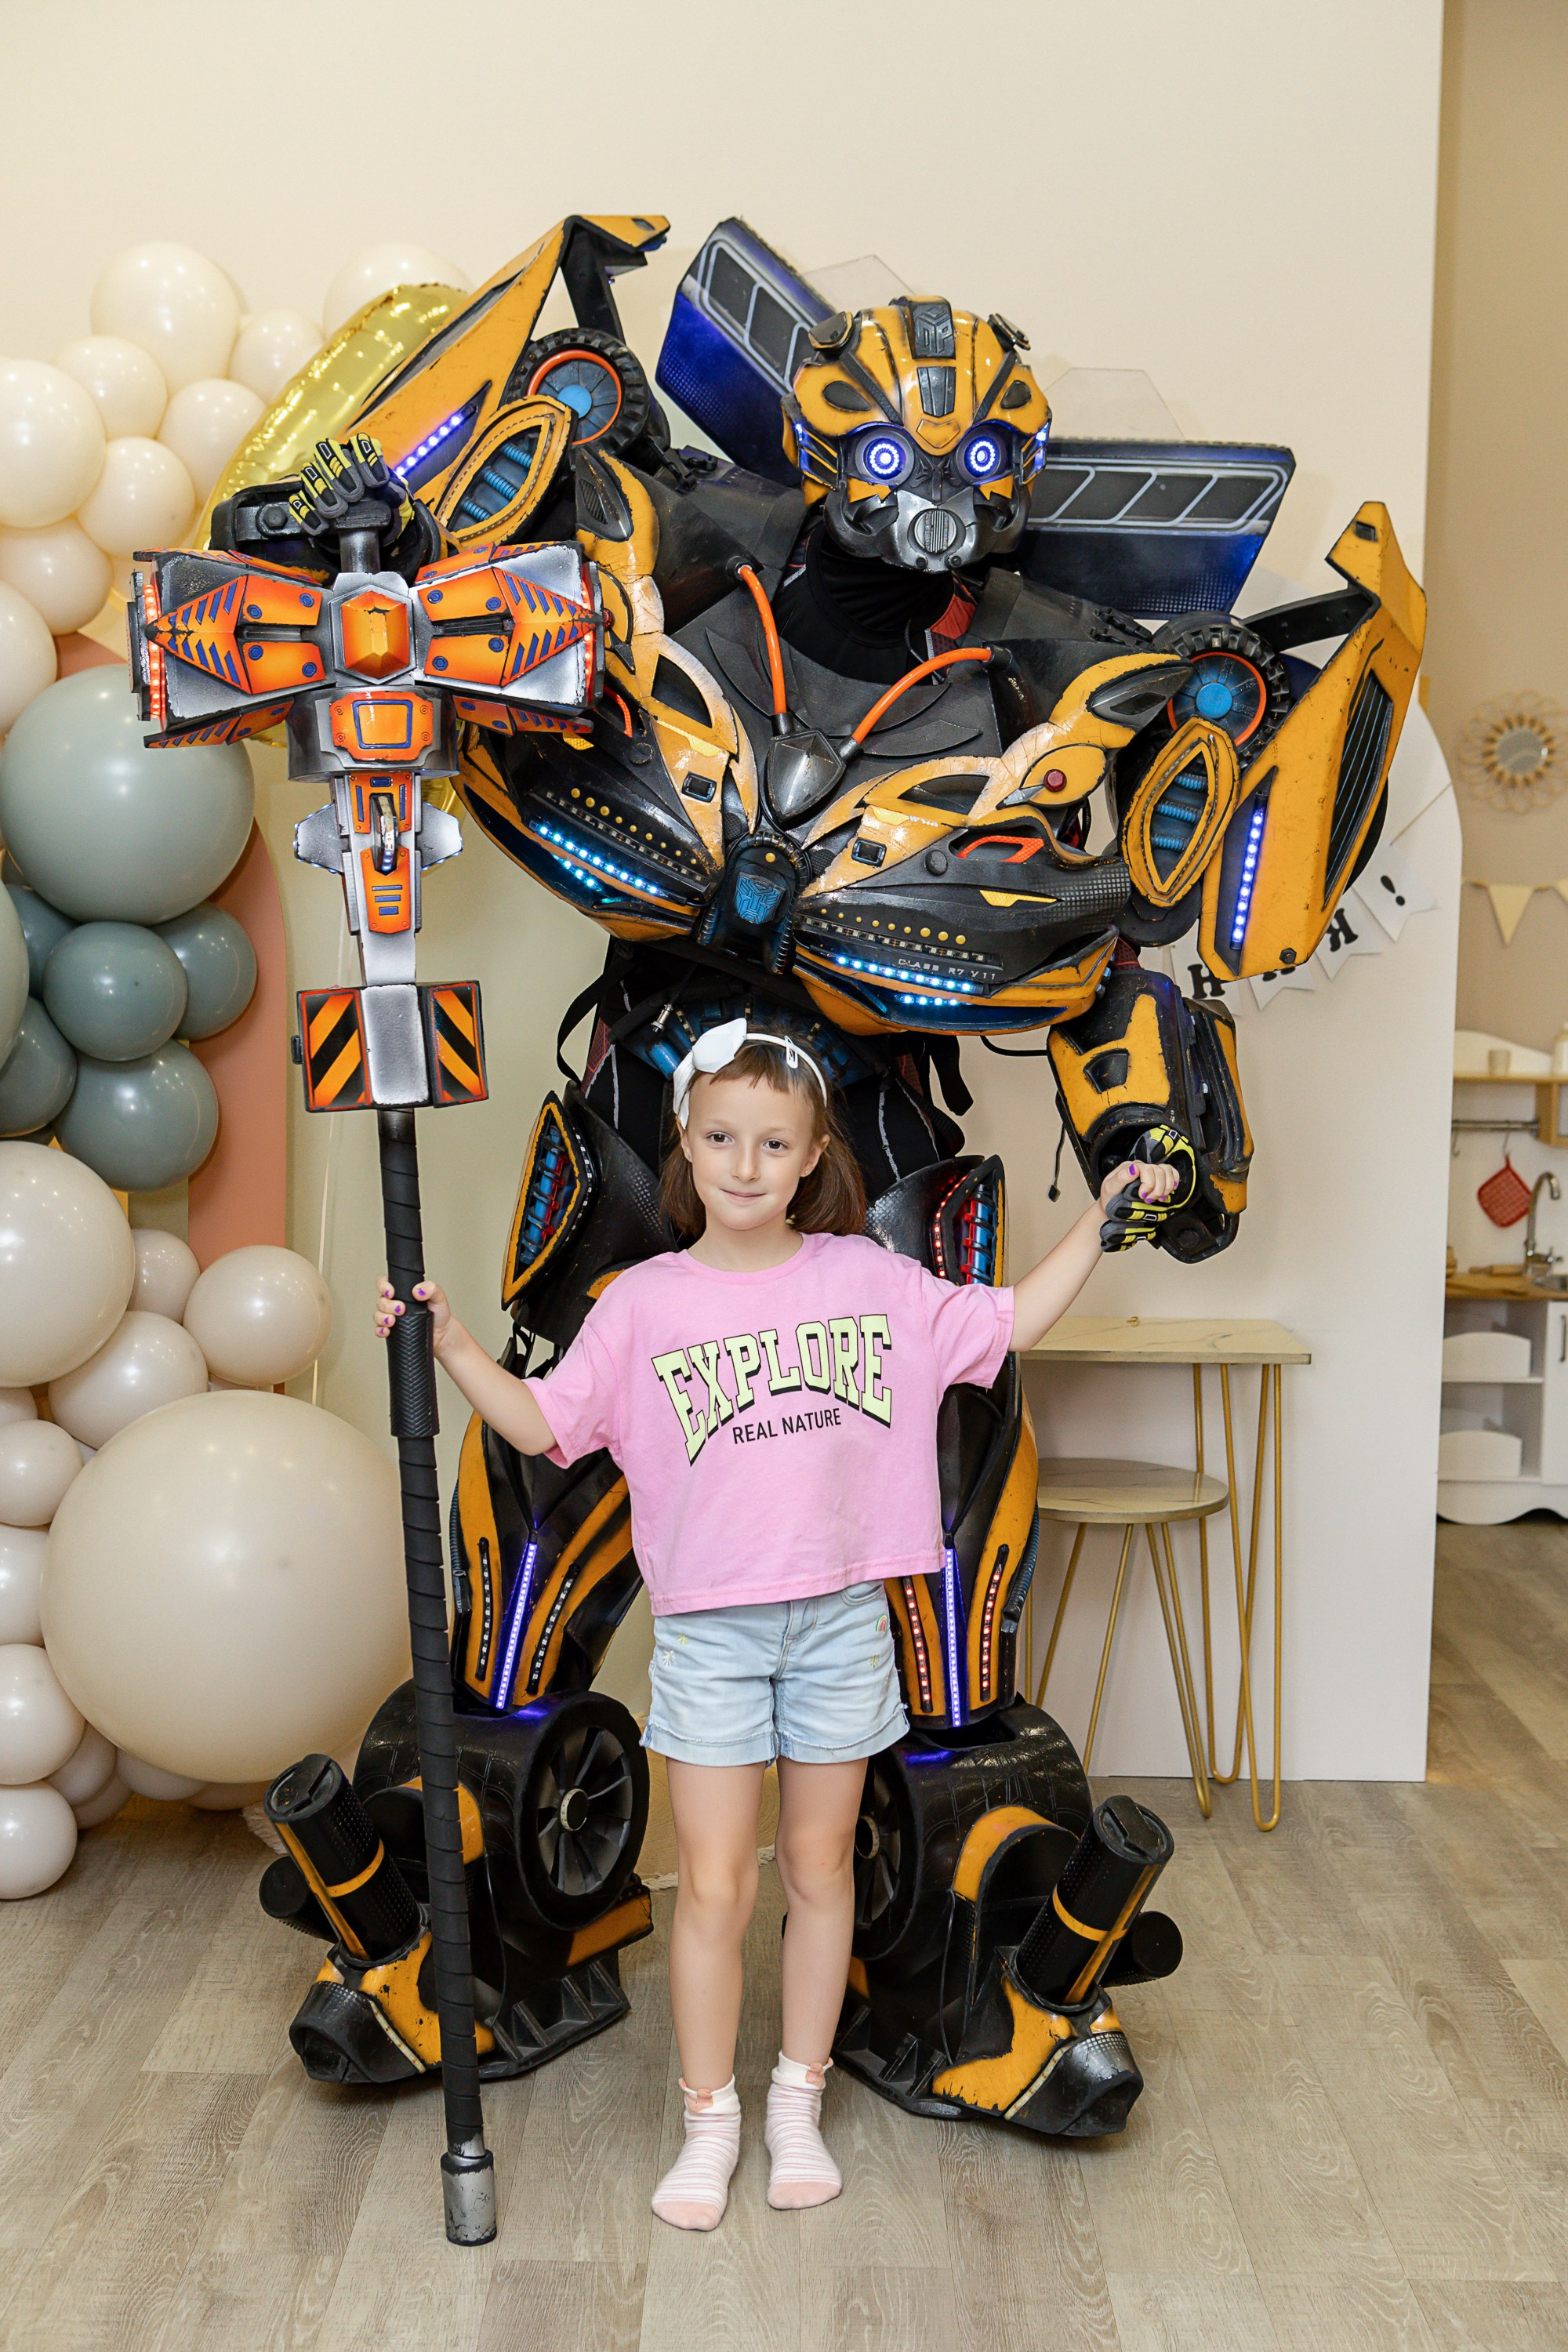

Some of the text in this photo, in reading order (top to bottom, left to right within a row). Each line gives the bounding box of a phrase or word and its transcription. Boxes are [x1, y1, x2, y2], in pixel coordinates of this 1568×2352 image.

[652, 1314, 892, 1467] EXPLORE
[732, 1407, 842, 1445] REAL NATURE
